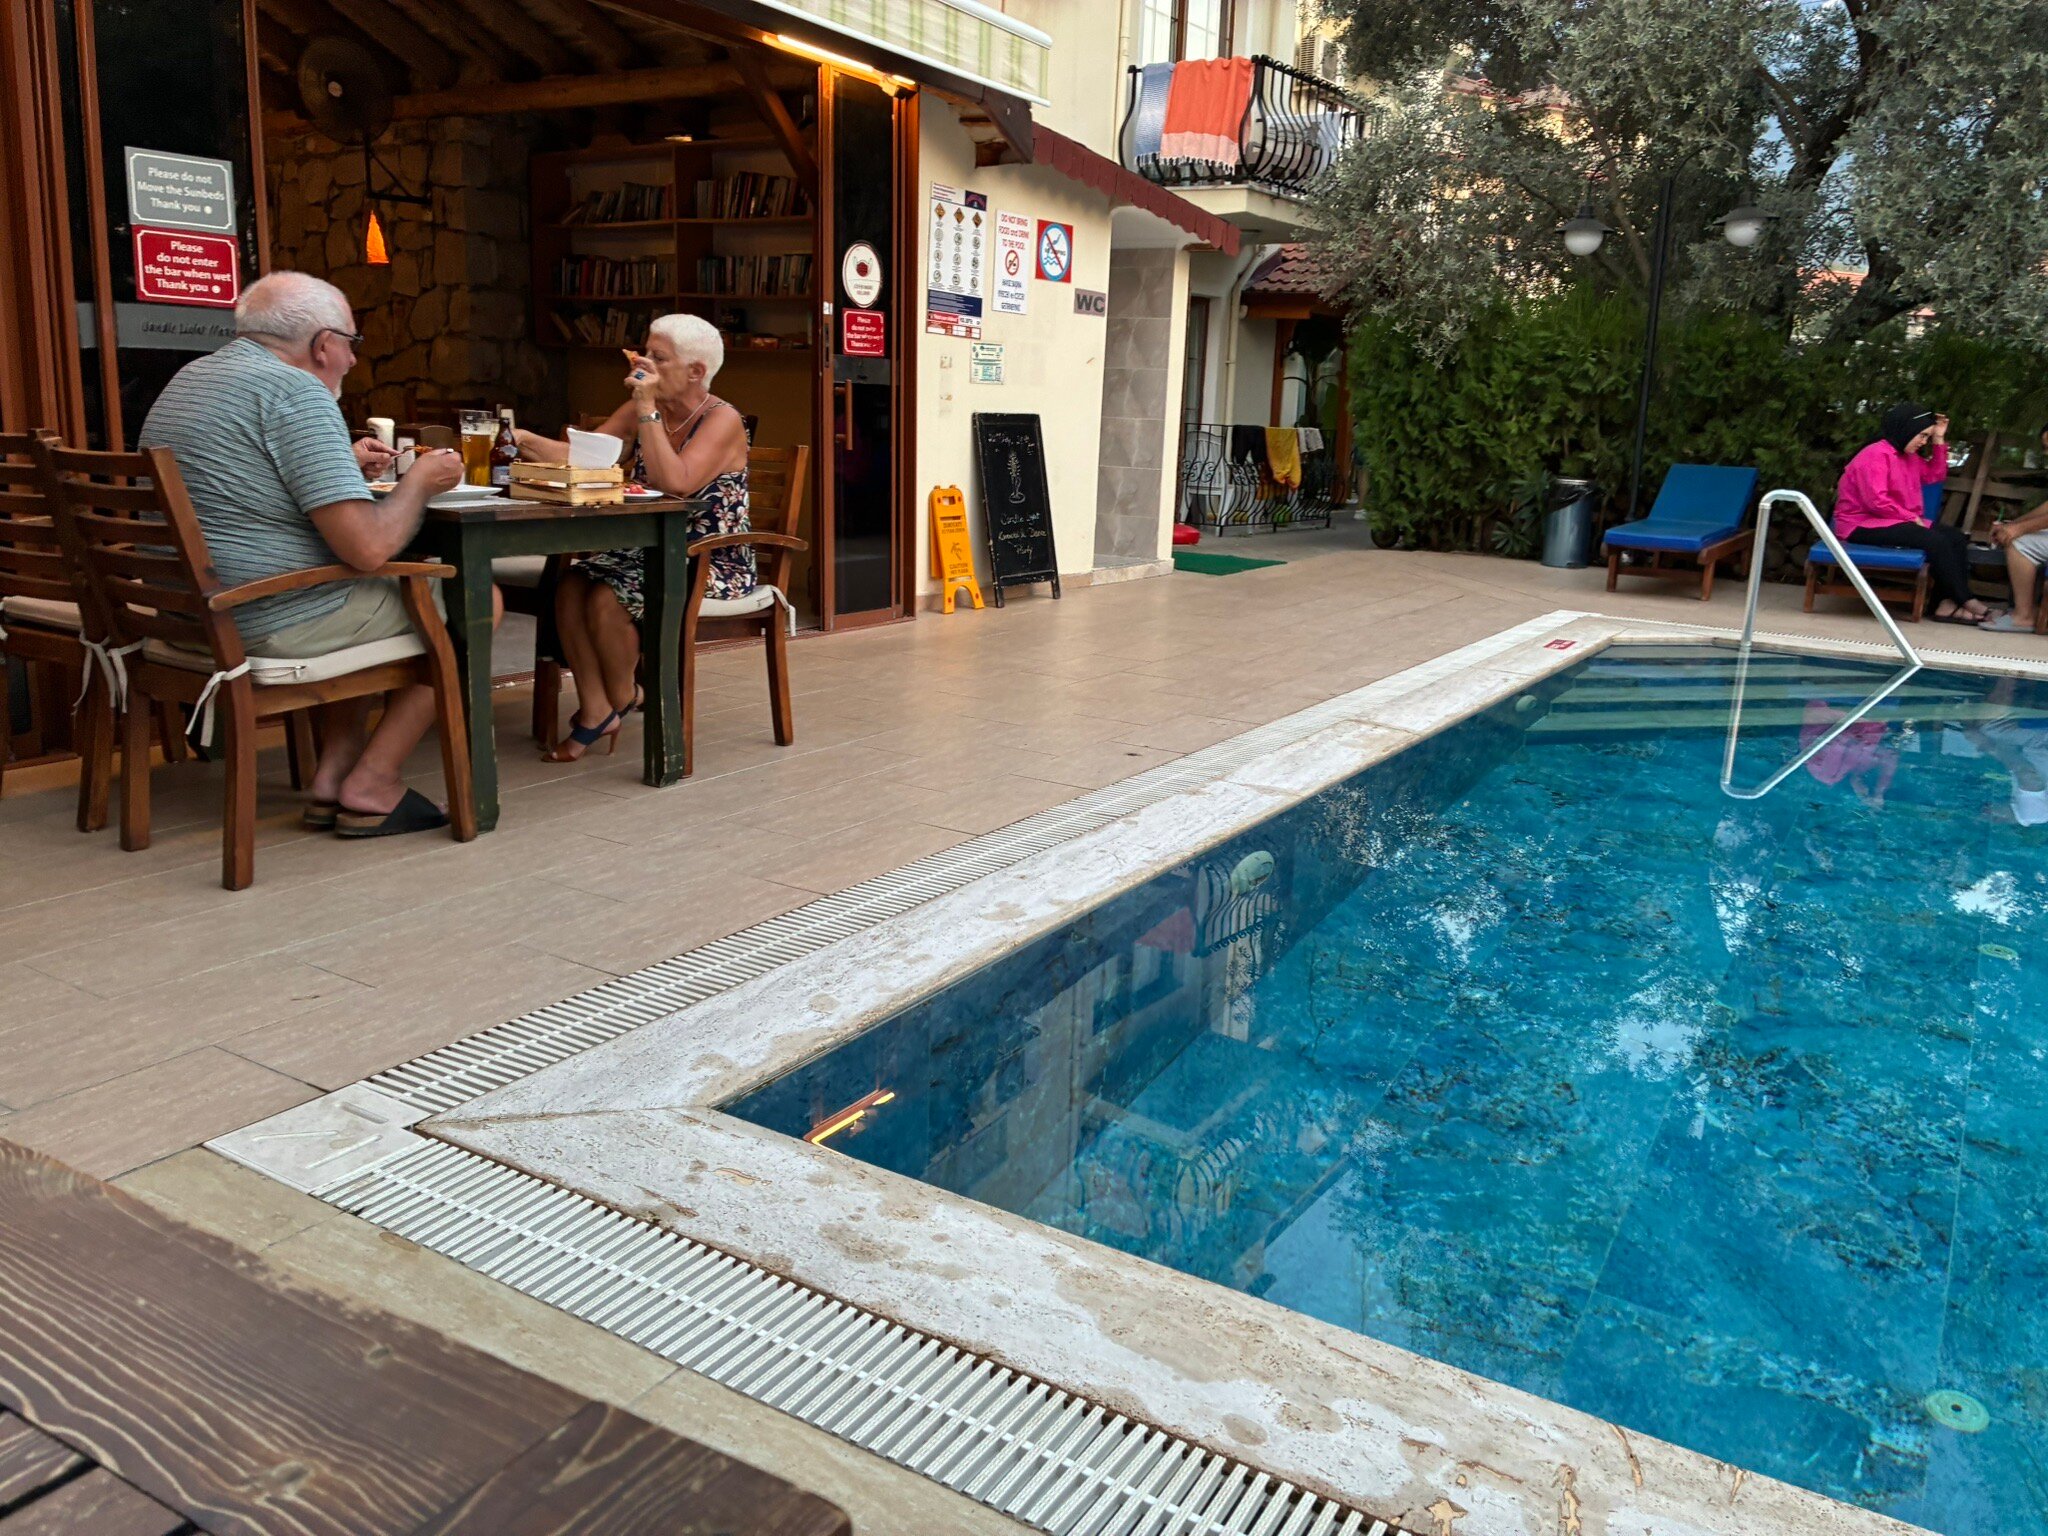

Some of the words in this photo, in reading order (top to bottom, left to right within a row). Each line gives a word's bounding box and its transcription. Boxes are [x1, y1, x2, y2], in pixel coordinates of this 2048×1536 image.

[148, 167, 179, 180] Please
[181, 171, 194, 182] do
[195, 175, 213, 185] not
[137, 181, 165, 193] Move
[166, 185, 183, 196] the
[183, 186, 225, 201] Sunbeds
[150, 197, 181, 210] Thank
[182, 203, 201, 213] you
[171, 240, 204, 253] Please
[157, 252, 171, 262] do
[172, 256, 191, 265] not
[192, 258, 219, 267] enter
[145, 264, 163, 274] the
[164, 266, 182, 276] bar
[183, 269, 211, 279] when
[212, 273, 232, 282] wet
[156, 278, 188, 290] Thank
[189, 283, 209, 293] you
[1077, 294, 1105, 313] WC
